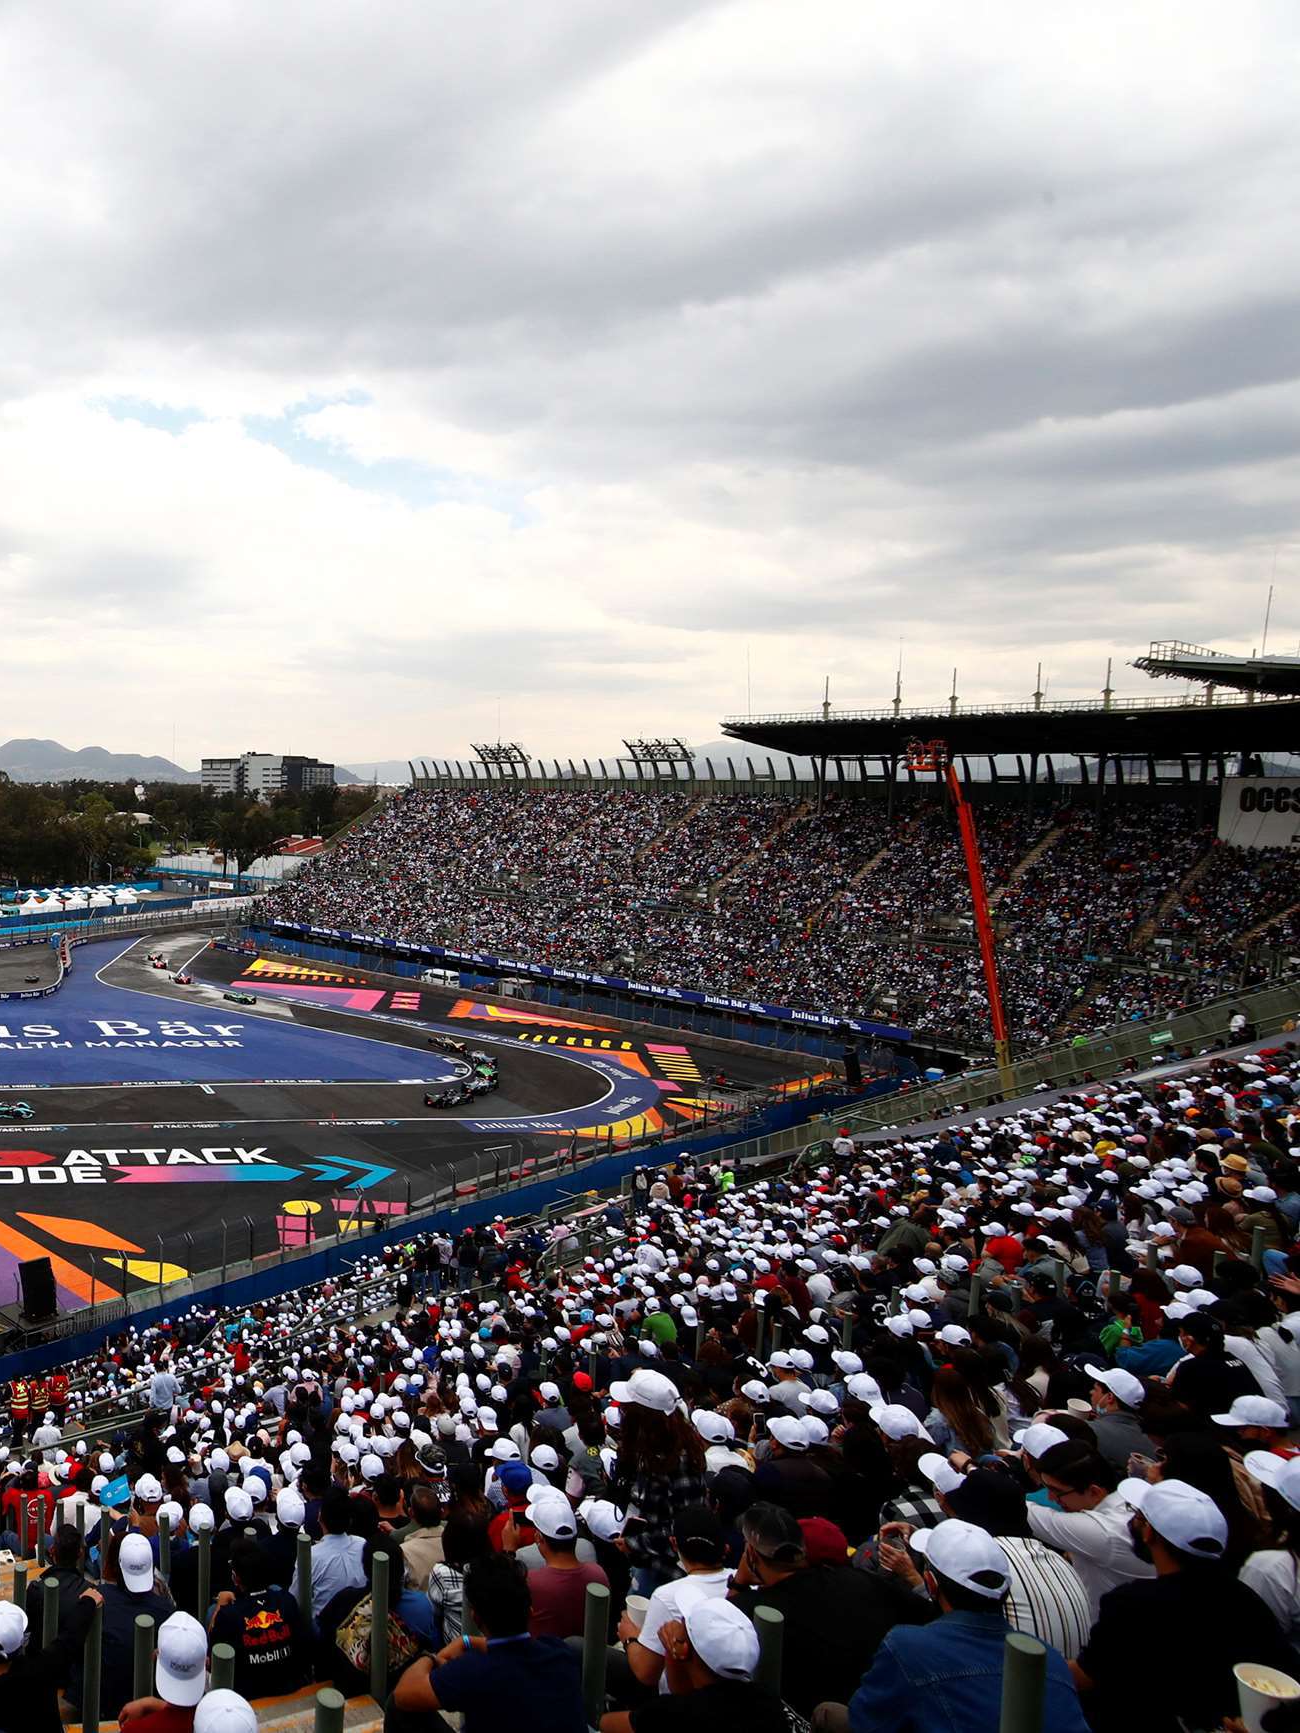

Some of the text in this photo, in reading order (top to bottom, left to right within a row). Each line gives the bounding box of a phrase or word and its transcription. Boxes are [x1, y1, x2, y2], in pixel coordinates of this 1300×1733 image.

[553, 968, 575, 978] Julius
[576, 972, 590, 980] Bär
[628, 981, 650, 992] Julius
[651, 984, 665, 993] Bär
[704, 994, 729, 1006] Julius
[731, 998, 747, 1009] Bär
[791, 1010, 819, 1022] Julius
[821, 1014, 839, 1026] Bär
[88, 1020, 245, 1038] Bär
[84, 1040, 245, 1048] MANAGER
[474, 1122, 563, 1131] Julius Bär
[61, 1147, 280, 1166] ATTACK
[243, 1624, 292, 1648] Red Bull
[249, 1649, 280, 1665] Mobil
